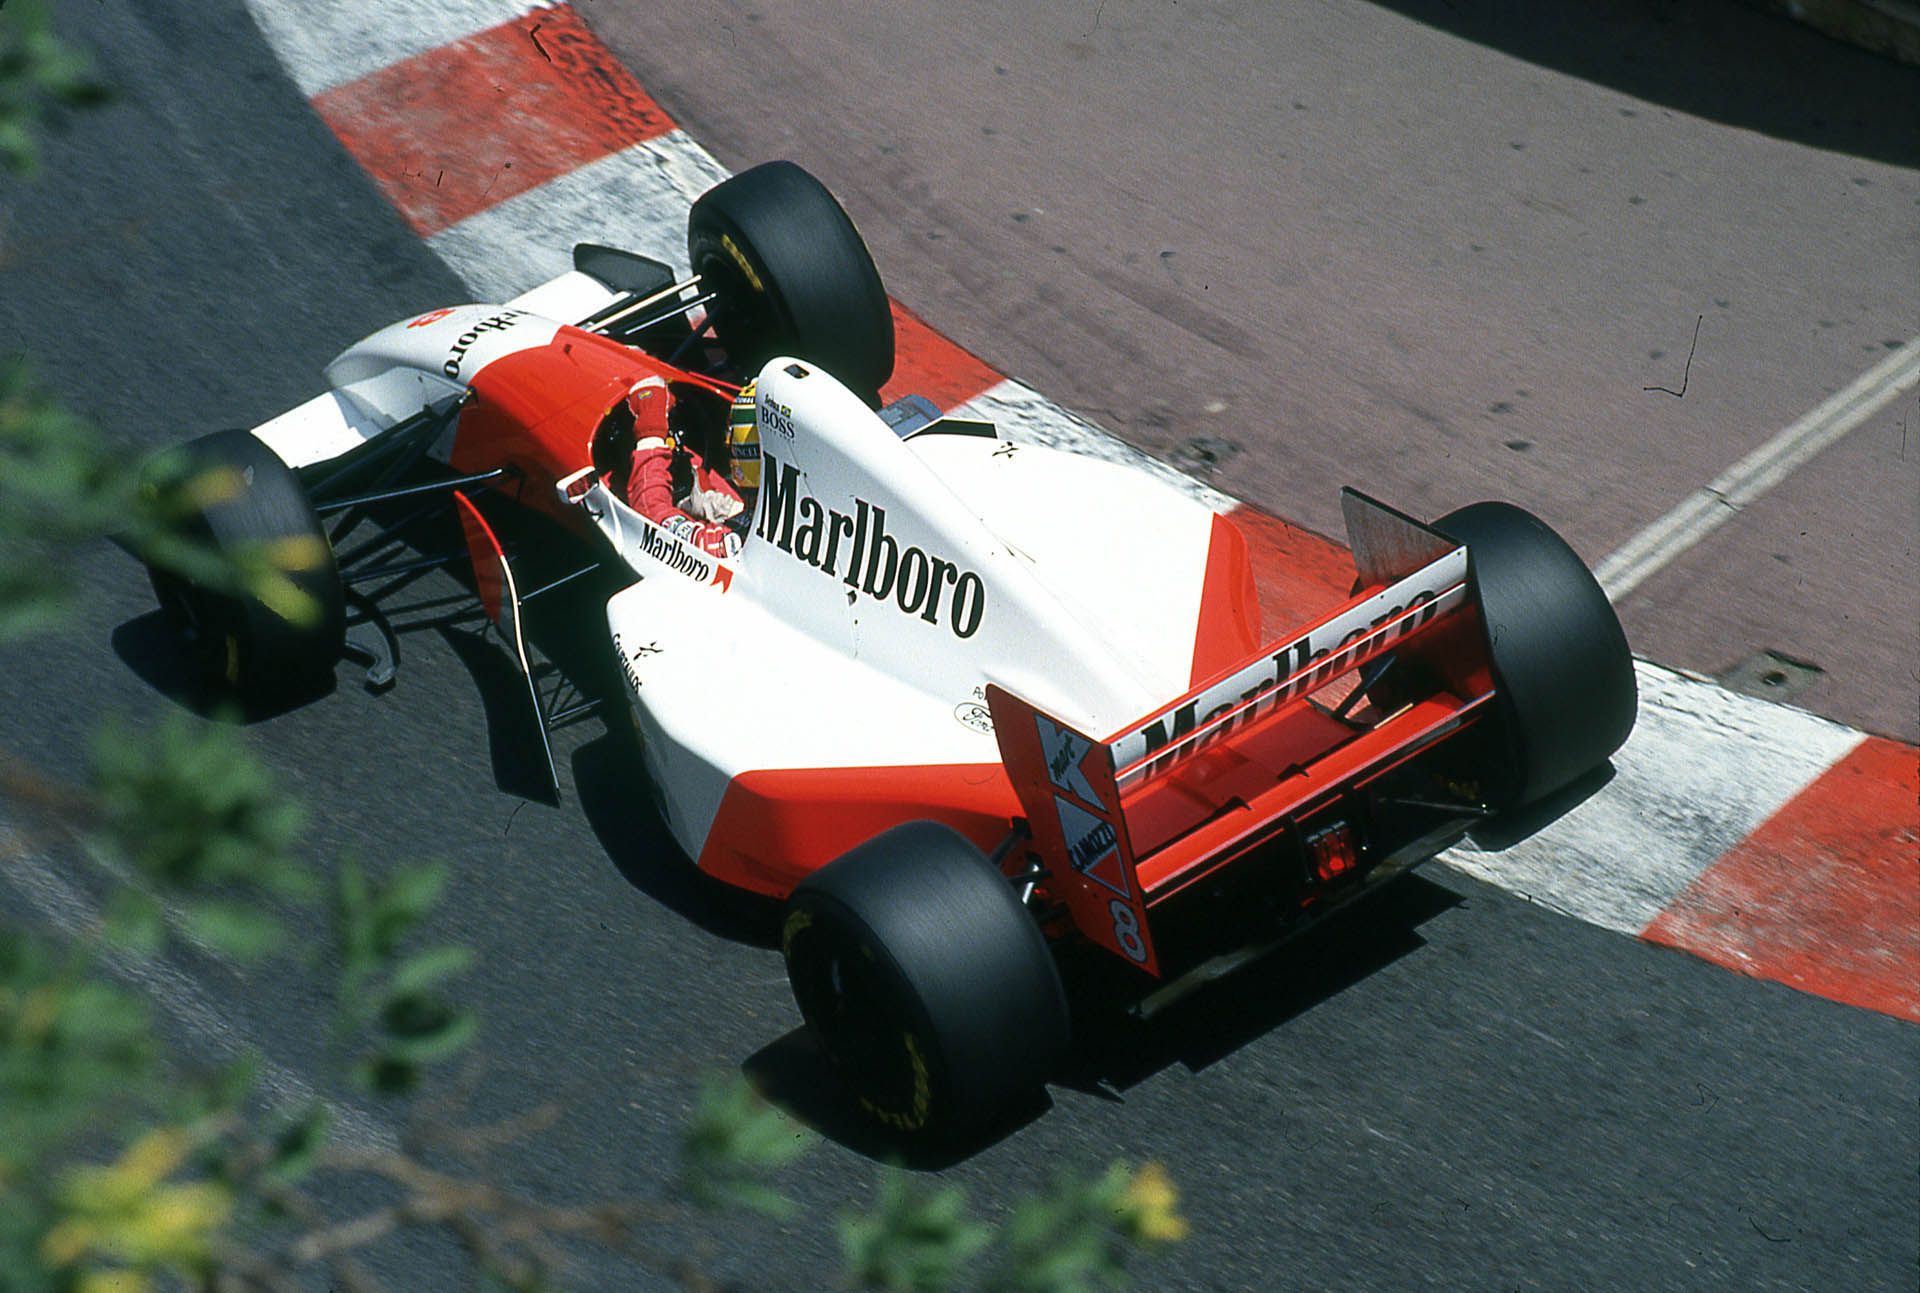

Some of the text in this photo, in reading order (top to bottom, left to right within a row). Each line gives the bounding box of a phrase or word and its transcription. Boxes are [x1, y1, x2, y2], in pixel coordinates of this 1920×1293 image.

[443, 308, 533, 381] rlboro
[761, 406, 796, 440] BOSS
[639, 523, 710, 583] Marlboro
[755, 451, 985, 639] Marlboro
[1140, 589, 1440, 780] Marlboro
[1109, 900, 1148, 963] 8
